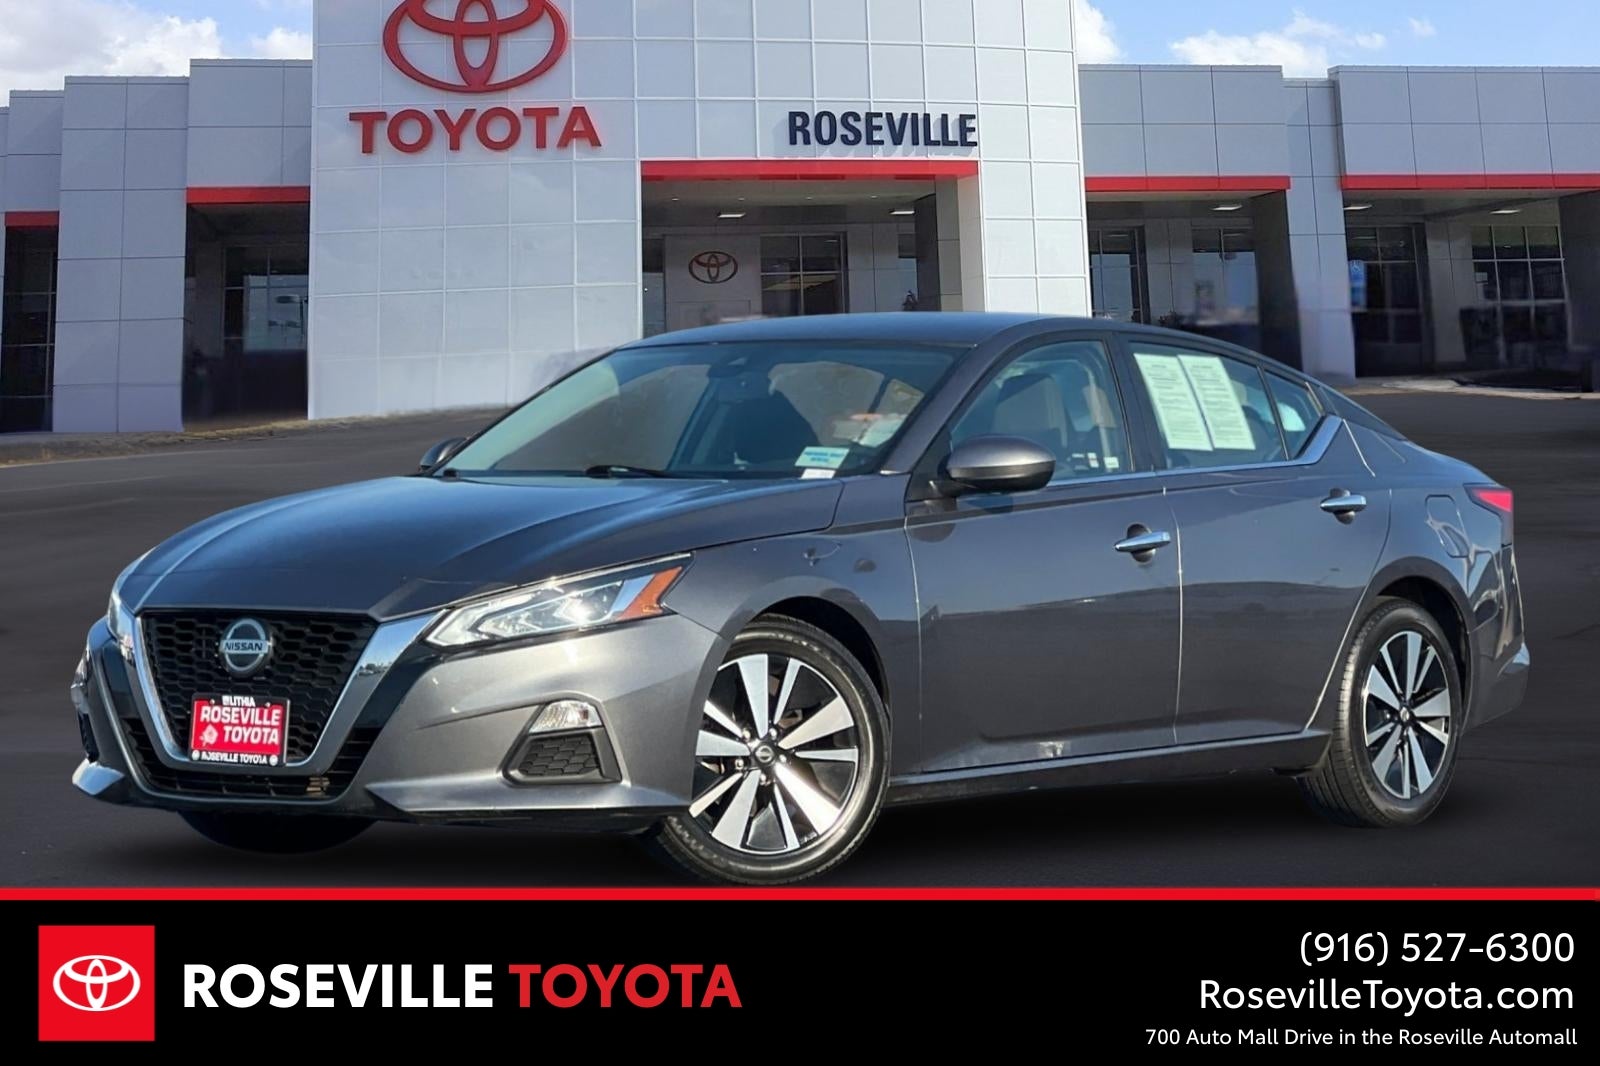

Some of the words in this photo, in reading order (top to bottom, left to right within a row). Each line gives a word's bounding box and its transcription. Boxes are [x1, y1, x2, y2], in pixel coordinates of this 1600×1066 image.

[349, 106, 602, 154] TOYOTA
[788, 110, 978, 148] ROSEVILLE
[225, 642, 263, 651] NISSAN
[200, 705, 281, 726] ROSEVILLE
[223, 726, 279, 745] TOYOTA
